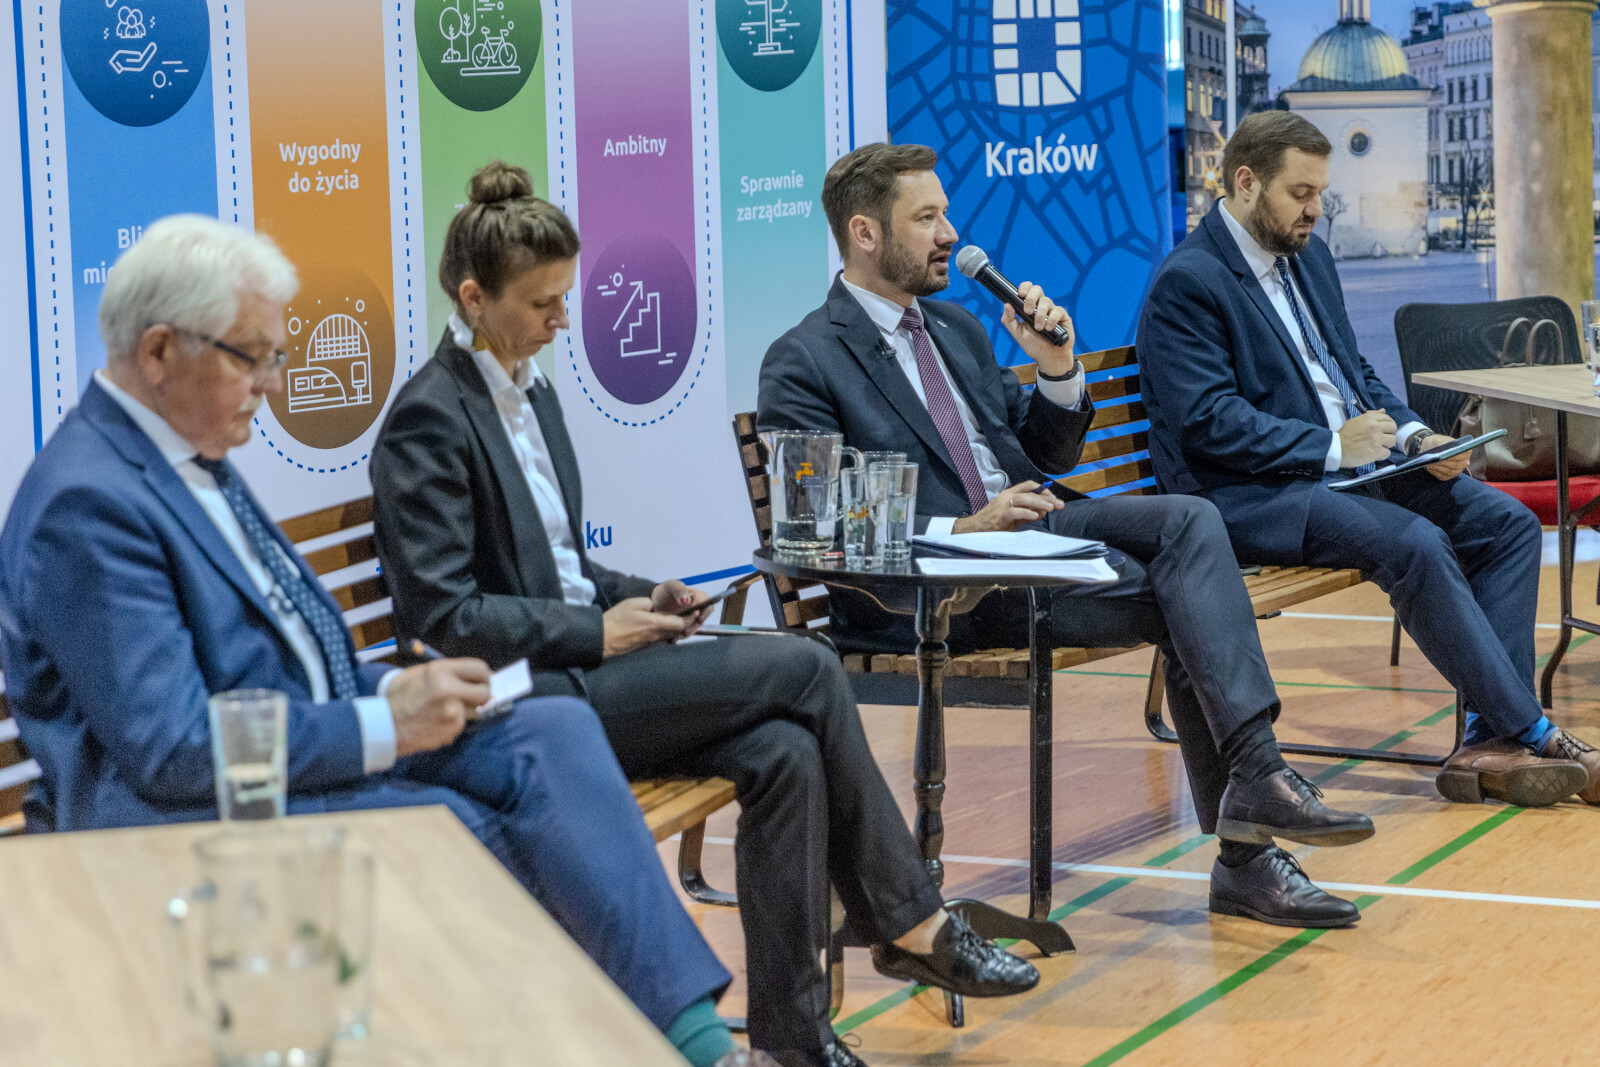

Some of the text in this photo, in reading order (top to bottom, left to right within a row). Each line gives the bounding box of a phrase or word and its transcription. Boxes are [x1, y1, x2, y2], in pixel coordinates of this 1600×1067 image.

[279, 138, 361, 165] Wygodny
[603, 135, 666, 158] Ambitny
[985, 133, 1098, 177] Kraków
[289, 169, 359, 195] do życia
[740, 171, 804, 195] Sprawnie
[737, 199, 813, 223] zarządzany
[118, 226, 144, 250] Bli
[83, 261, 112, 285] mi
[584, 521, 613, 549] ku
